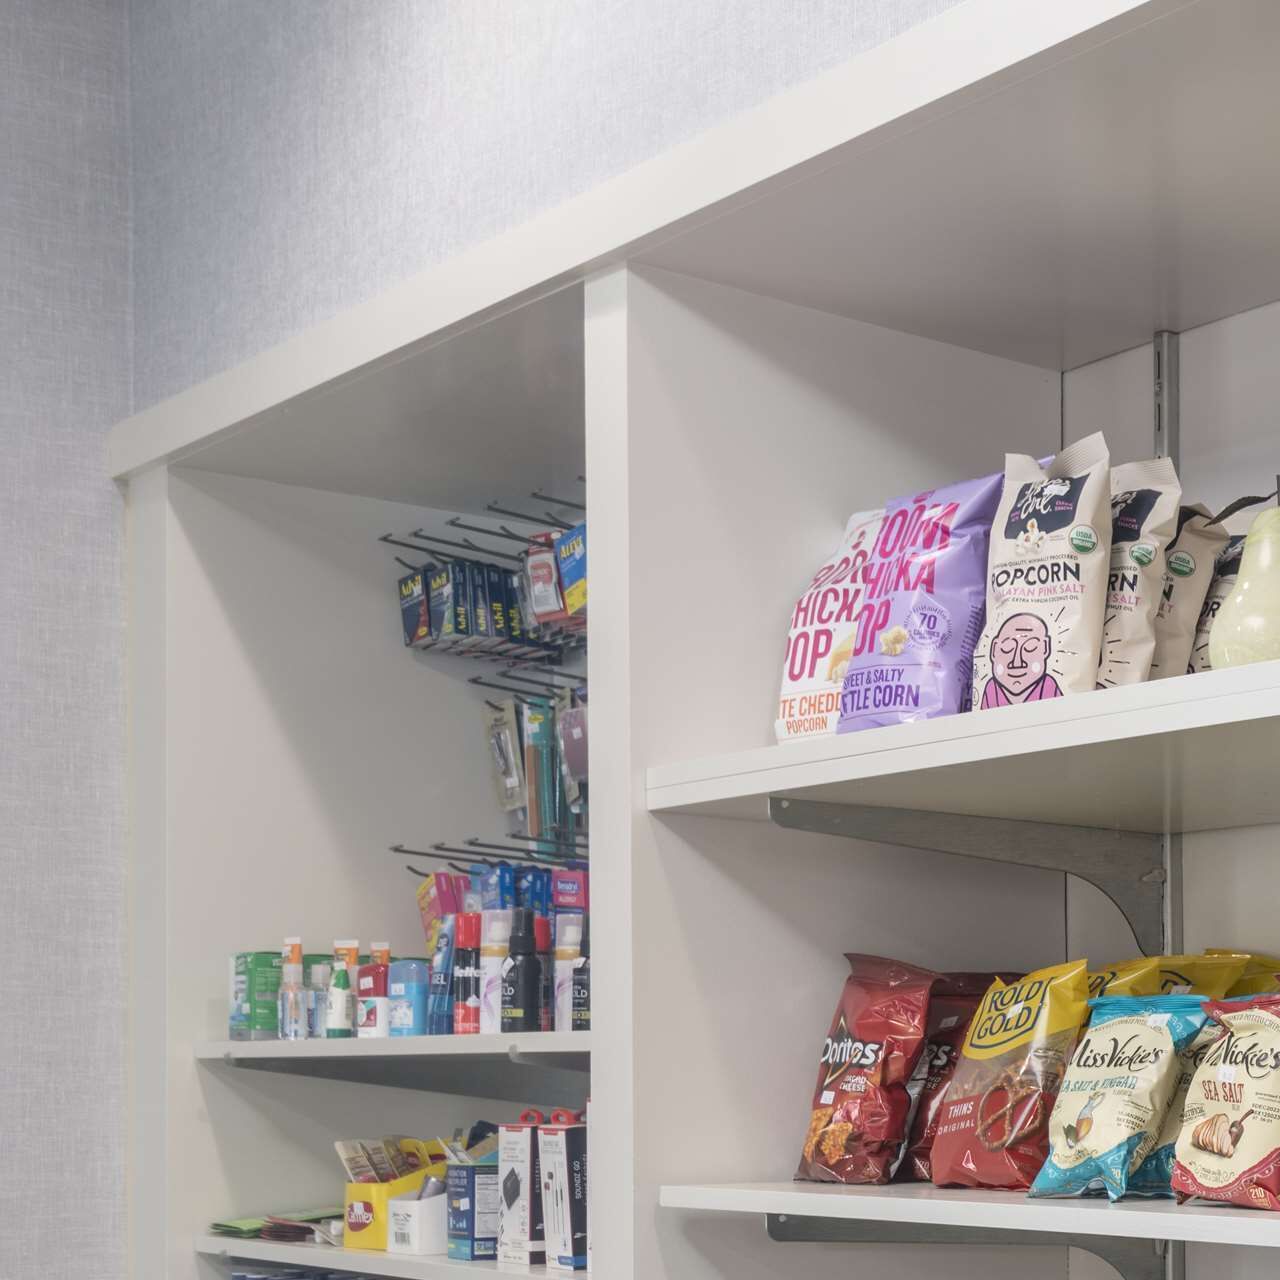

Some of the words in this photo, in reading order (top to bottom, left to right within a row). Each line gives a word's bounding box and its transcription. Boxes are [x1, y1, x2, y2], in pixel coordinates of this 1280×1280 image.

[992, 562, 1080, 592] POPCORN
[1038, 586, 1057, 596] PINK
[1059, 584, 1085, 594] SALT
[920, 612, 937, 630] 70
[872, 668, 904, 683] SALTY
[872, 685, 921, 709] CORN
[786, 716, 828, 734] POPCORN
[989, 978, 1042, 1012] ROLD
[977, 1003, 1032, 1040] GOLD
[820, 1037, 882, 1065] Doritos
[1108, 1035, 1164, 1072] Vickie's
[1201, 1080, 1220, 1101] SEA
[1223, 1080, 1244, 1104] SALT
[949, 1101, 974, 1118] THINS
[937, 1119, 975, 1136] ORIGINAL
[1250, 1187, 1263, 1198] 210
